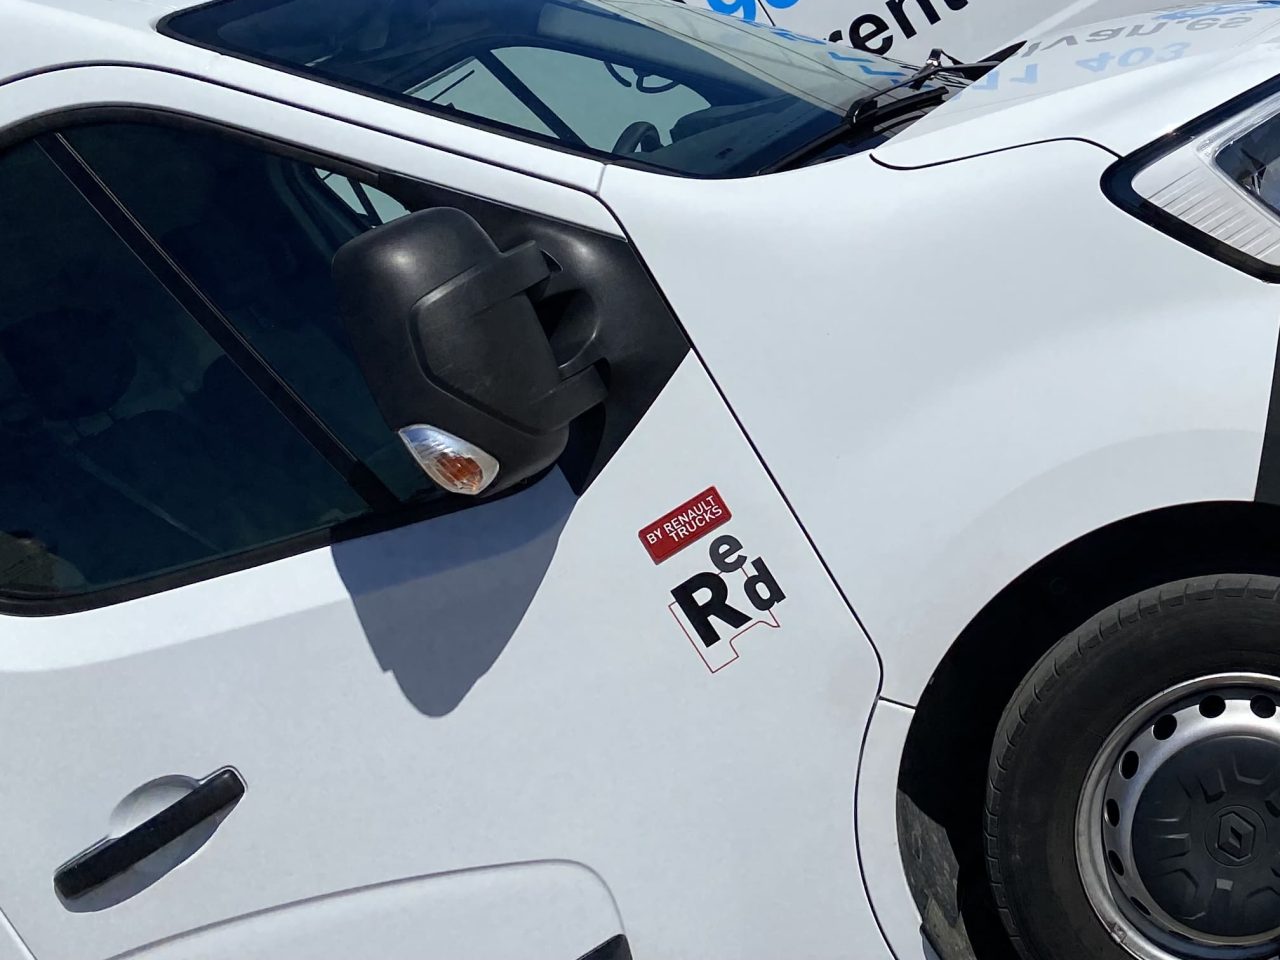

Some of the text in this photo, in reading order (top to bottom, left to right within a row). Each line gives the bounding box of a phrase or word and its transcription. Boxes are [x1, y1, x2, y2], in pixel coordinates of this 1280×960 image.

[646, 495, 716, 544] BY RENAULT
[669, 505, 723, 542] TRUCKS
[670, 534, 787, 648] Red
